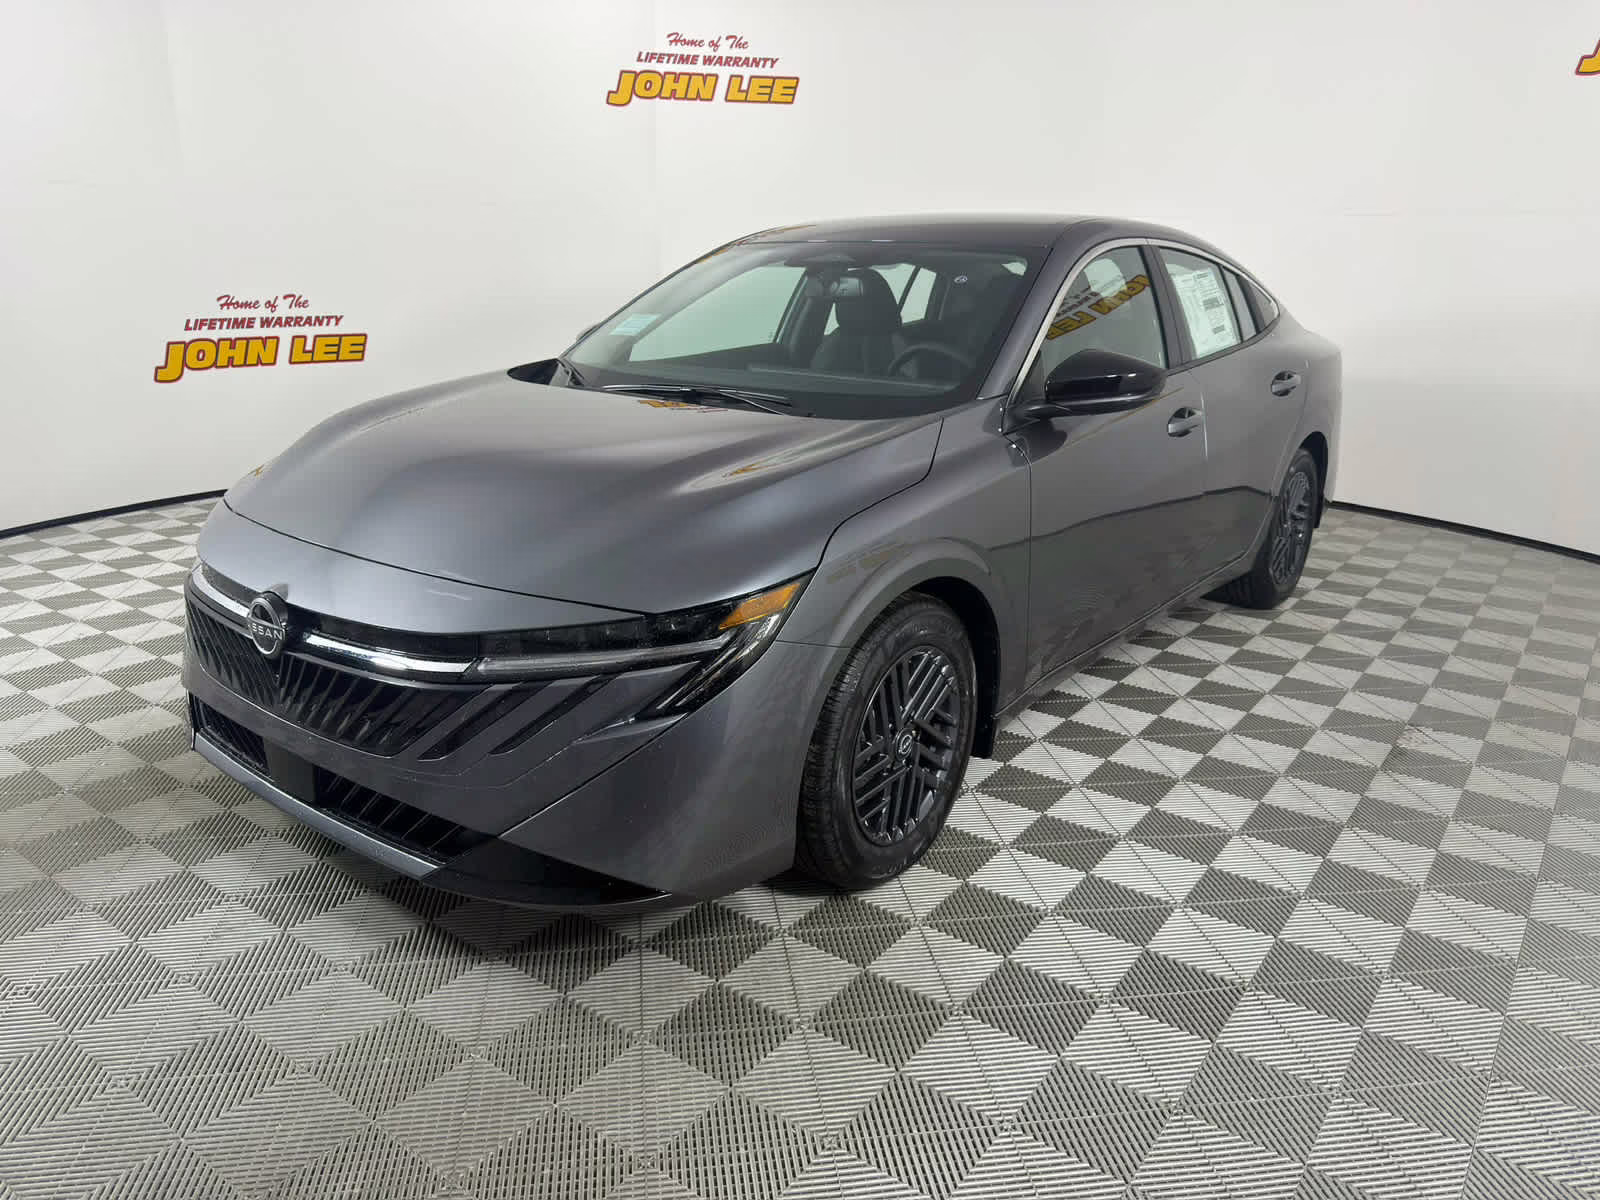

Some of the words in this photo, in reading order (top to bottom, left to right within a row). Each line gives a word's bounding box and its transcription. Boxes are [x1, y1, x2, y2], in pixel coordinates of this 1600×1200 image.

[666, 32, 705, 47] Home
[708, 36, 722, 52] of
[725, 35, 750, 50] The
[636, 51, 700, 66] LIFETIME
[702, 55, 779, 69] WARRANTY
[606, 70, 719, 107] JOHN
[725, 74, 799, 104] LEE
[216, 294, 261, 310] Home
[264, 295, 279, 313] of
[283, 293, 310, 310] The
[184, 317, 256, 332] LIFETIME
[259, 315, 344, 329] WARRANTY
[154, 335, 280, 384] JOHN
[288, 333, 368, 365] LEE
